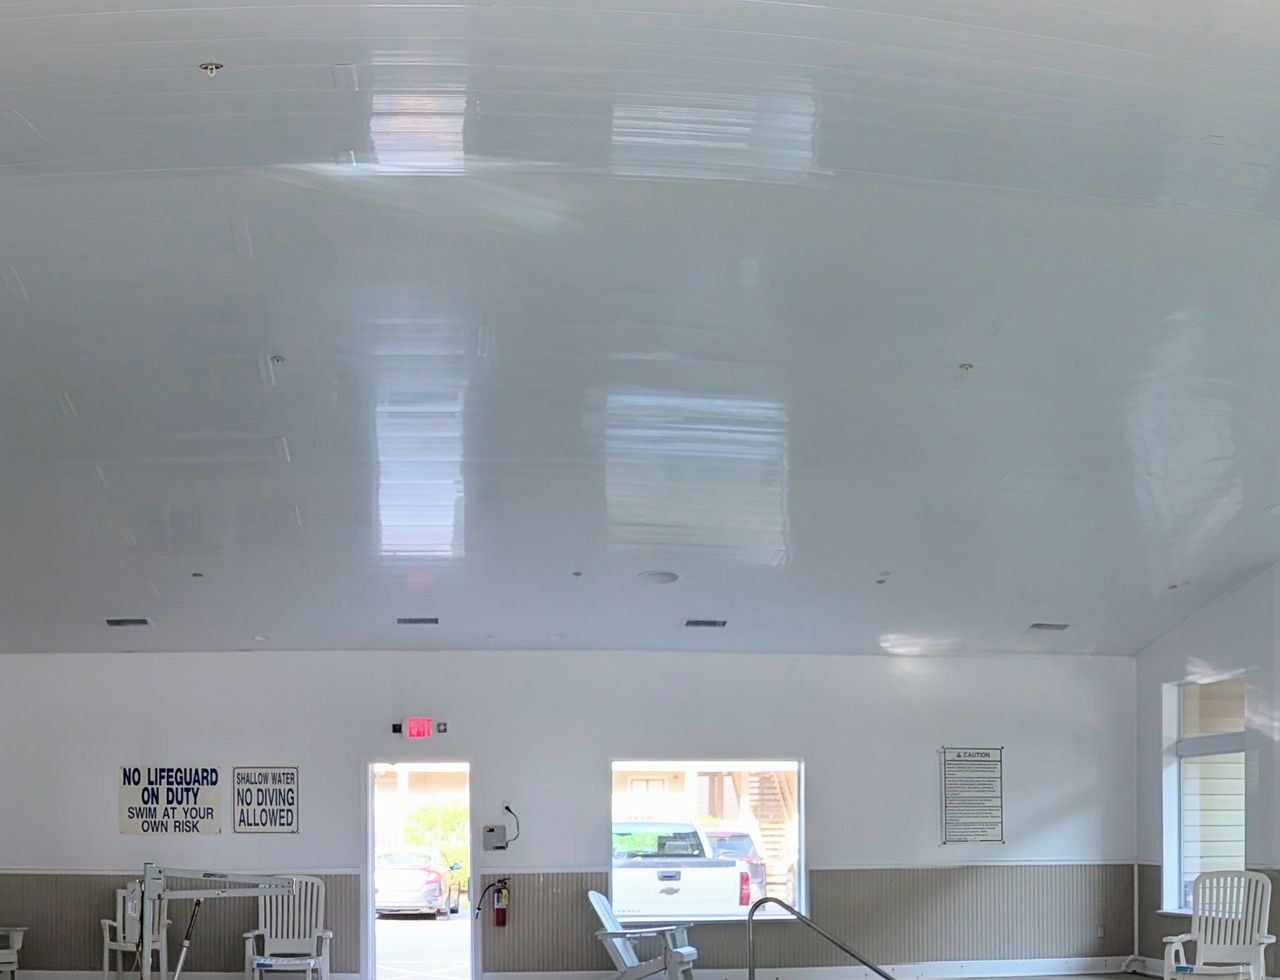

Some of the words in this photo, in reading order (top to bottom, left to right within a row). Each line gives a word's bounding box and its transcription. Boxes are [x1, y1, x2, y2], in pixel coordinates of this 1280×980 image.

[408, 718, 432, 737] EXIT
[123, 768, 140, 785] NO
[148, 768, 218, 786] LIFEGUARD
[236, 773, 268, 784] SHALLOW
[272, 773, 295, 784] WATER
[142, 788, 159, 805] ON
[166, 788, 199, 805] DUTY
[237, 789, 252, 806] NO
[257, 788, 294, 806] DIVING
[128, 807, 156, 819] SWIM
[163, 807, 176, 819] AT
[183, 807, 214, 819] YOUR
[239, 809, 294, 826] ALLOWED
[142, 821, 168, 832] OWN
[174, 821, 199, 832] RISK
